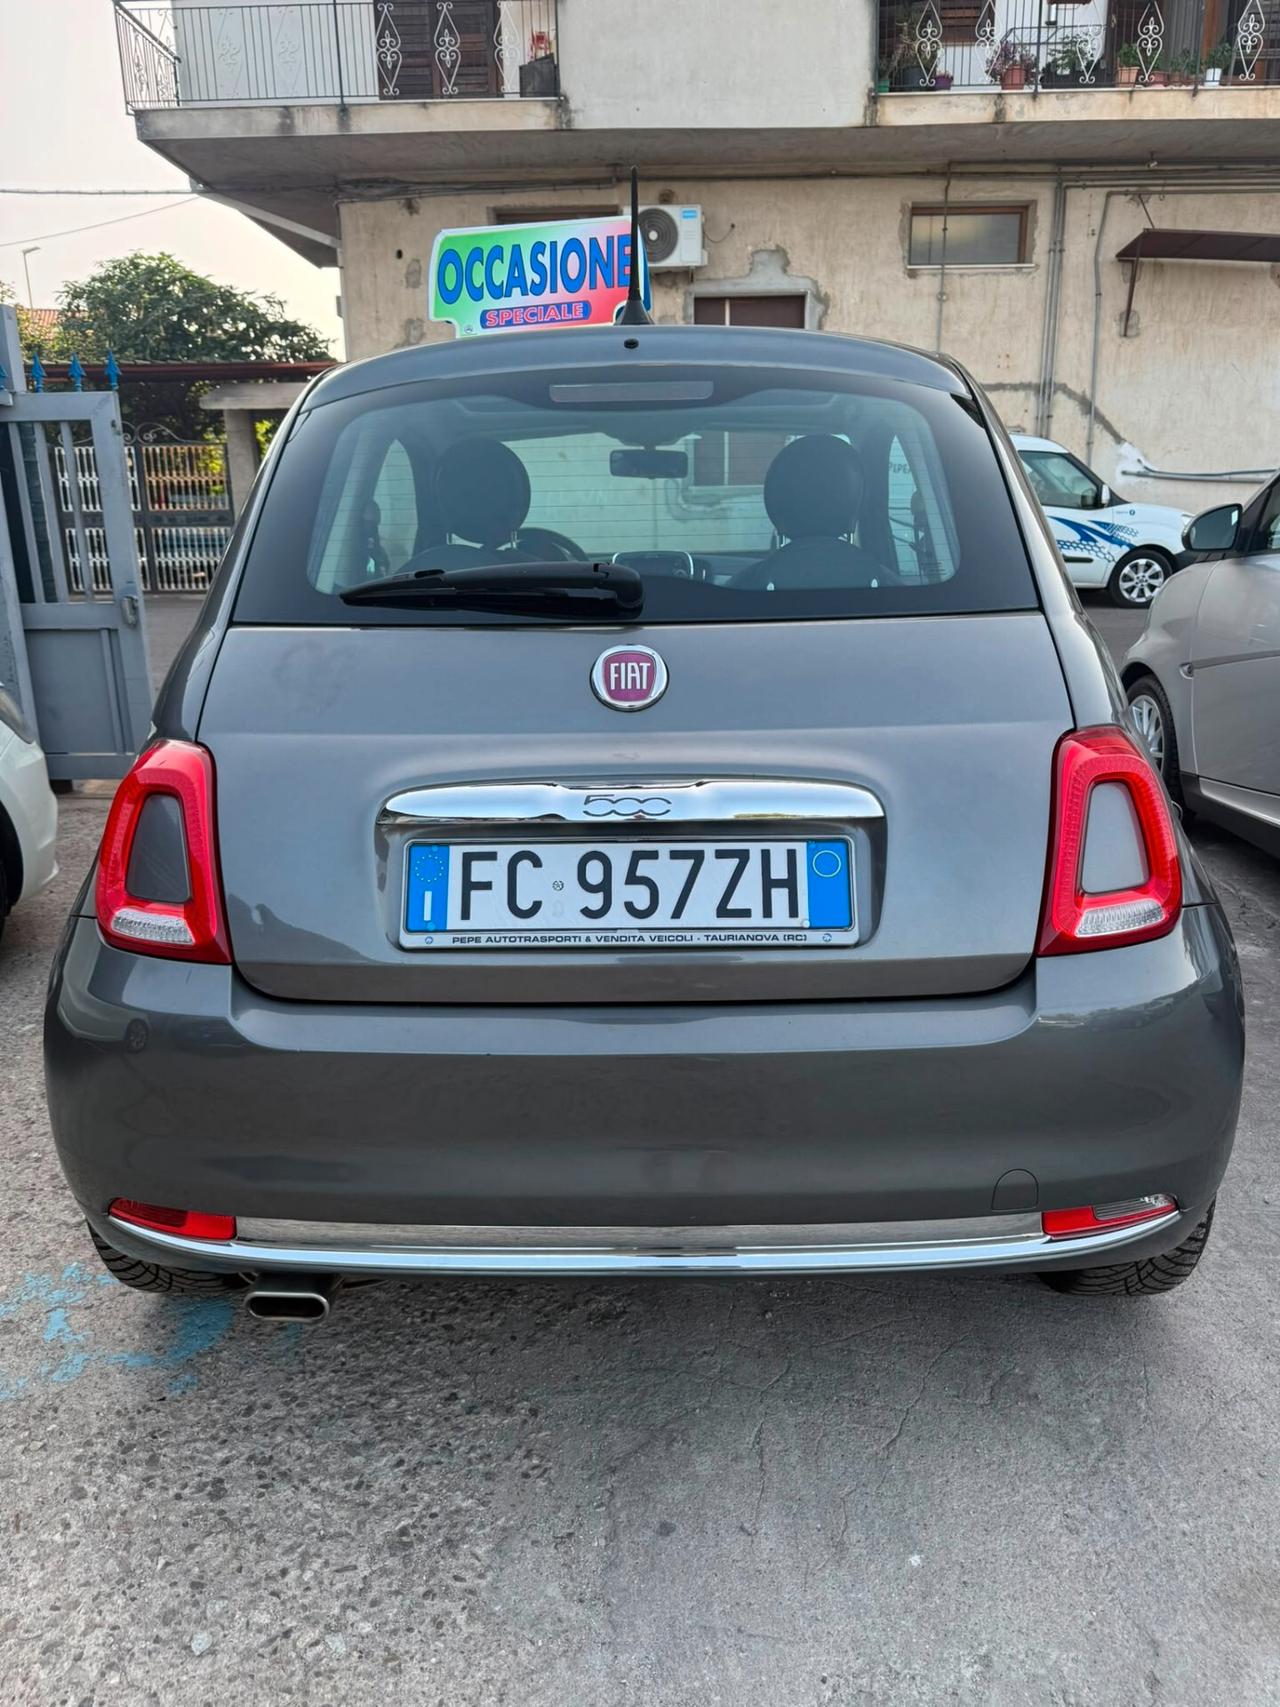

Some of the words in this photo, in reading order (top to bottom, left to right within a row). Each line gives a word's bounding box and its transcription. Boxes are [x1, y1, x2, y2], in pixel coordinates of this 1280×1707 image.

[437, 234, 632, 304] OCCASIONE
[486, 302, 584, 327] SPECIALE
[610, 662, 651, 690] FIAT
[583, 793, 672, 817] 500
[461, 850, 543, 920] FC
[577, 848, 799, 920] 957ZH
[452, 936, 482, 944] PEPE
[485, 935, 582, 943] AUTOTRASPORTI
[595, 935, 645, 943] VENDITA
[649, 934, 693, 942] VEICOLI
[704, 934, 779, 942] TAURIANOVA
[783, 934, 808, 942] (RC)
